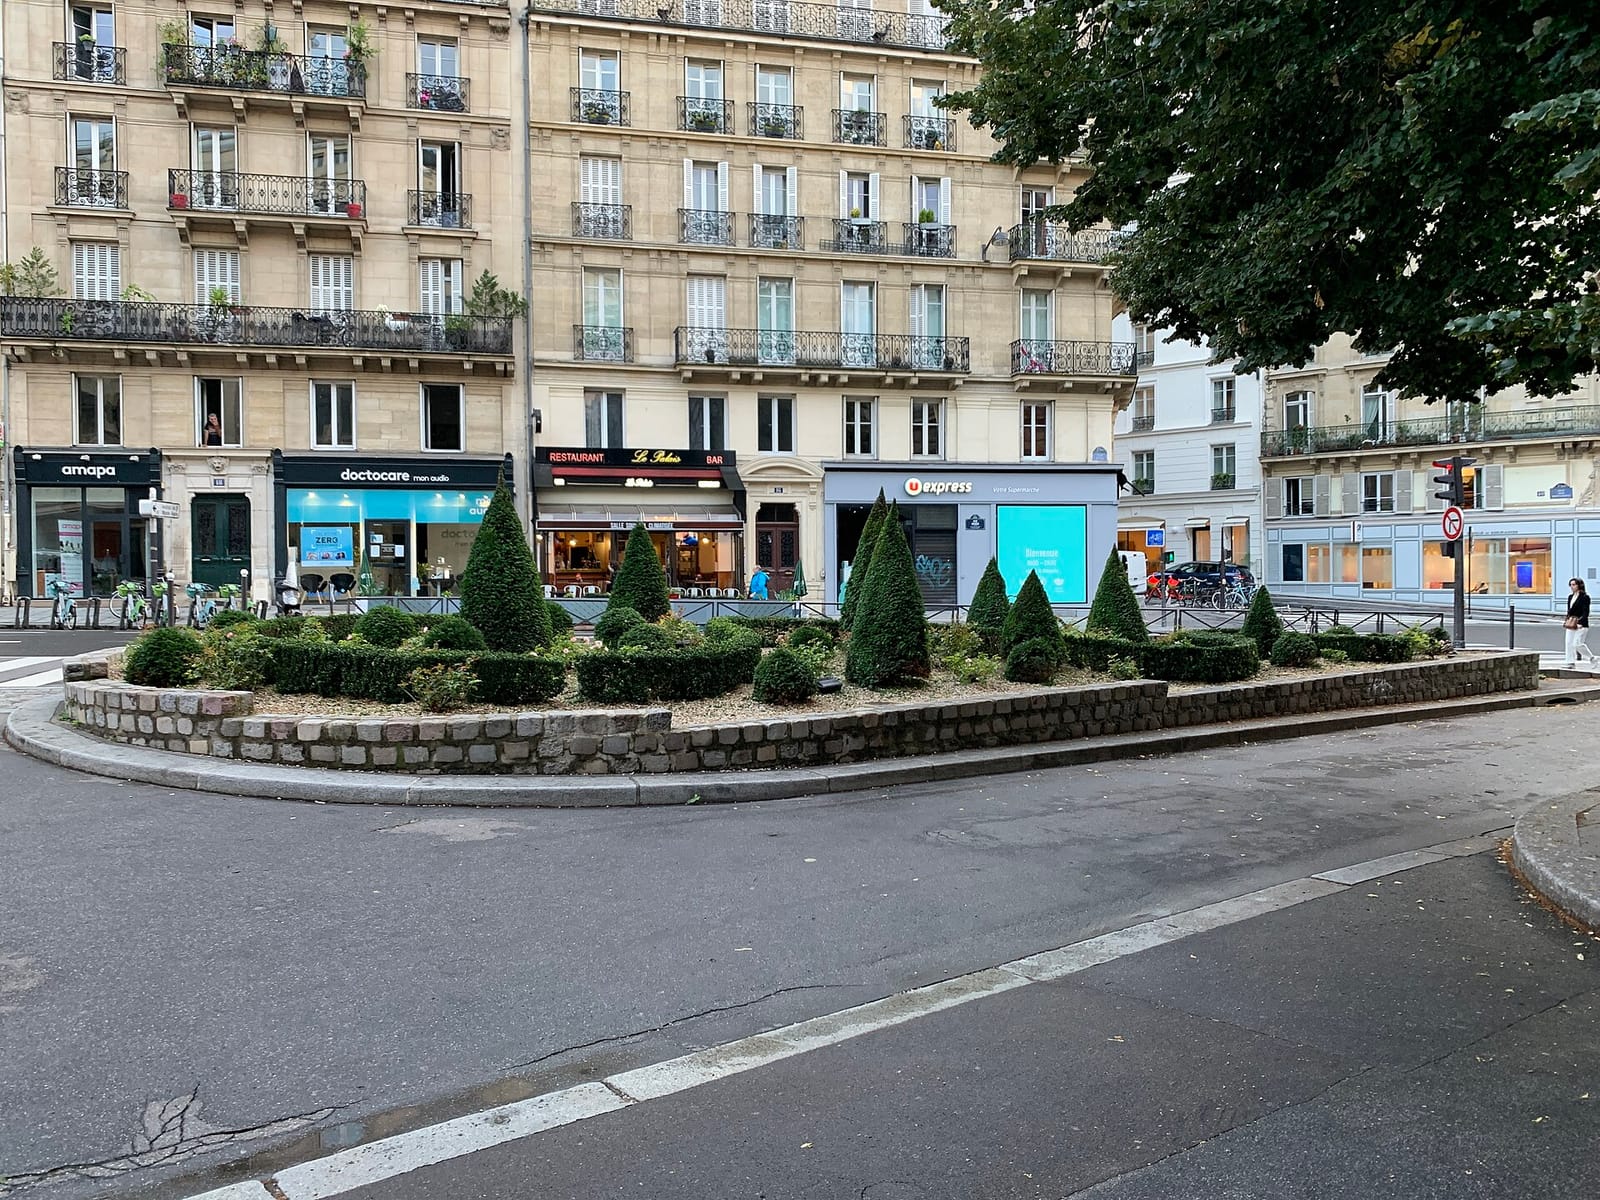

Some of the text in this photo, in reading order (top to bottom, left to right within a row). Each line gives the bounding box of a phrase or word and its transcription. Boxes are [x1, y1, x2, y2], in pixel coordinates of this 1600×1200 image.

[549, 452, 605, 463] RESTAURANT
[631, 449, 649, 463] Le
[706, 455, 723, 464] BAR
[61, 466, 116, 479] amapa
[340, 468, 410, 481] doctocare
[922, 482, 973, 496] express
[315, 536, 339, 544] ZERO
